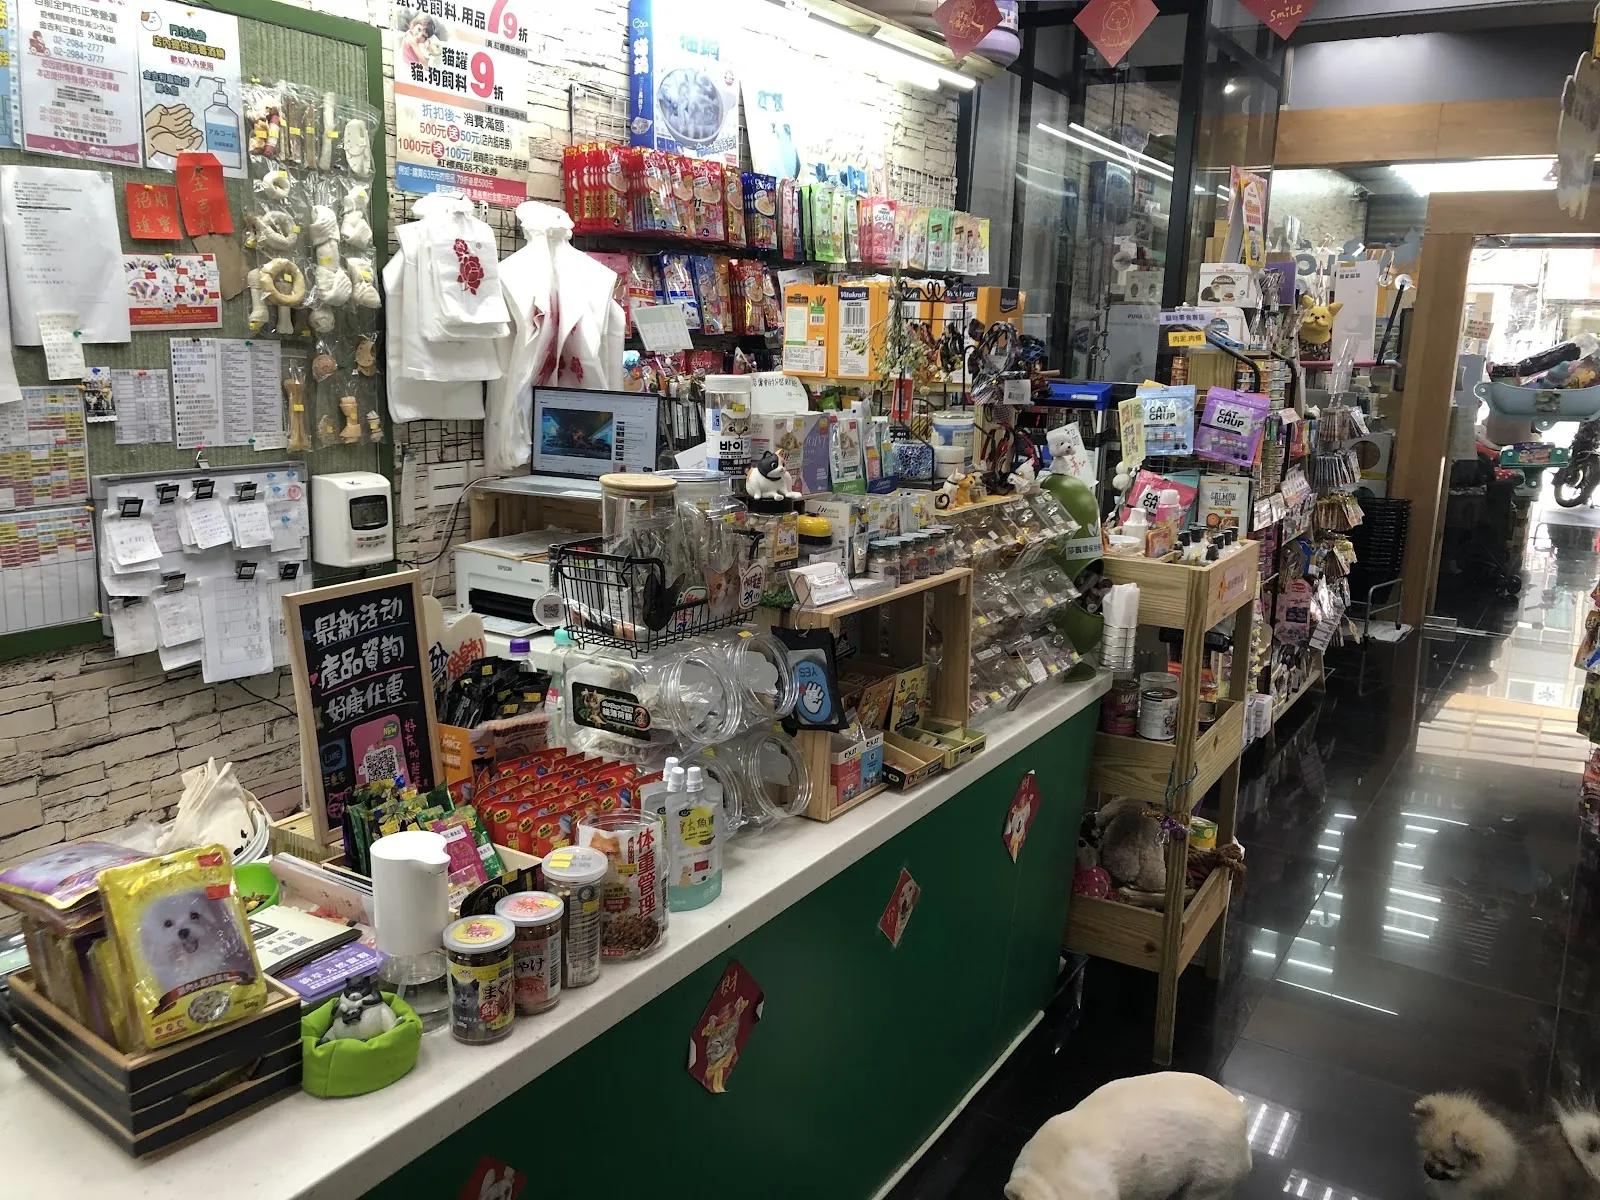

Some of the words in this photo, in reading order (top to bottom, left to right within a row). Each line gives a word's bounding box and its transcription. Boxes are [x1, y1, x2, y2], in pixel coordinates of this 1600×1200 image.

[169, 23, 207, 42] 門市公告
[208, 128, 237, 140] アルコール
[840, 286, 868, 298] Vitakraft
[1149, 405, 1169, 414] CAT
[1218, 408, 1239, 417] CAT
[1149, 412, 1176, 421] CHUP
[1216, 415, 1244, 428] CHUP
[497, 564, 513, 572] EPSON
[799, 667, 818, 678] YES
[383, 725, 398, 736] NEW
[636, 827, 657, 920] 体重管理
[481, 1000, 499, 1017] 鮪
